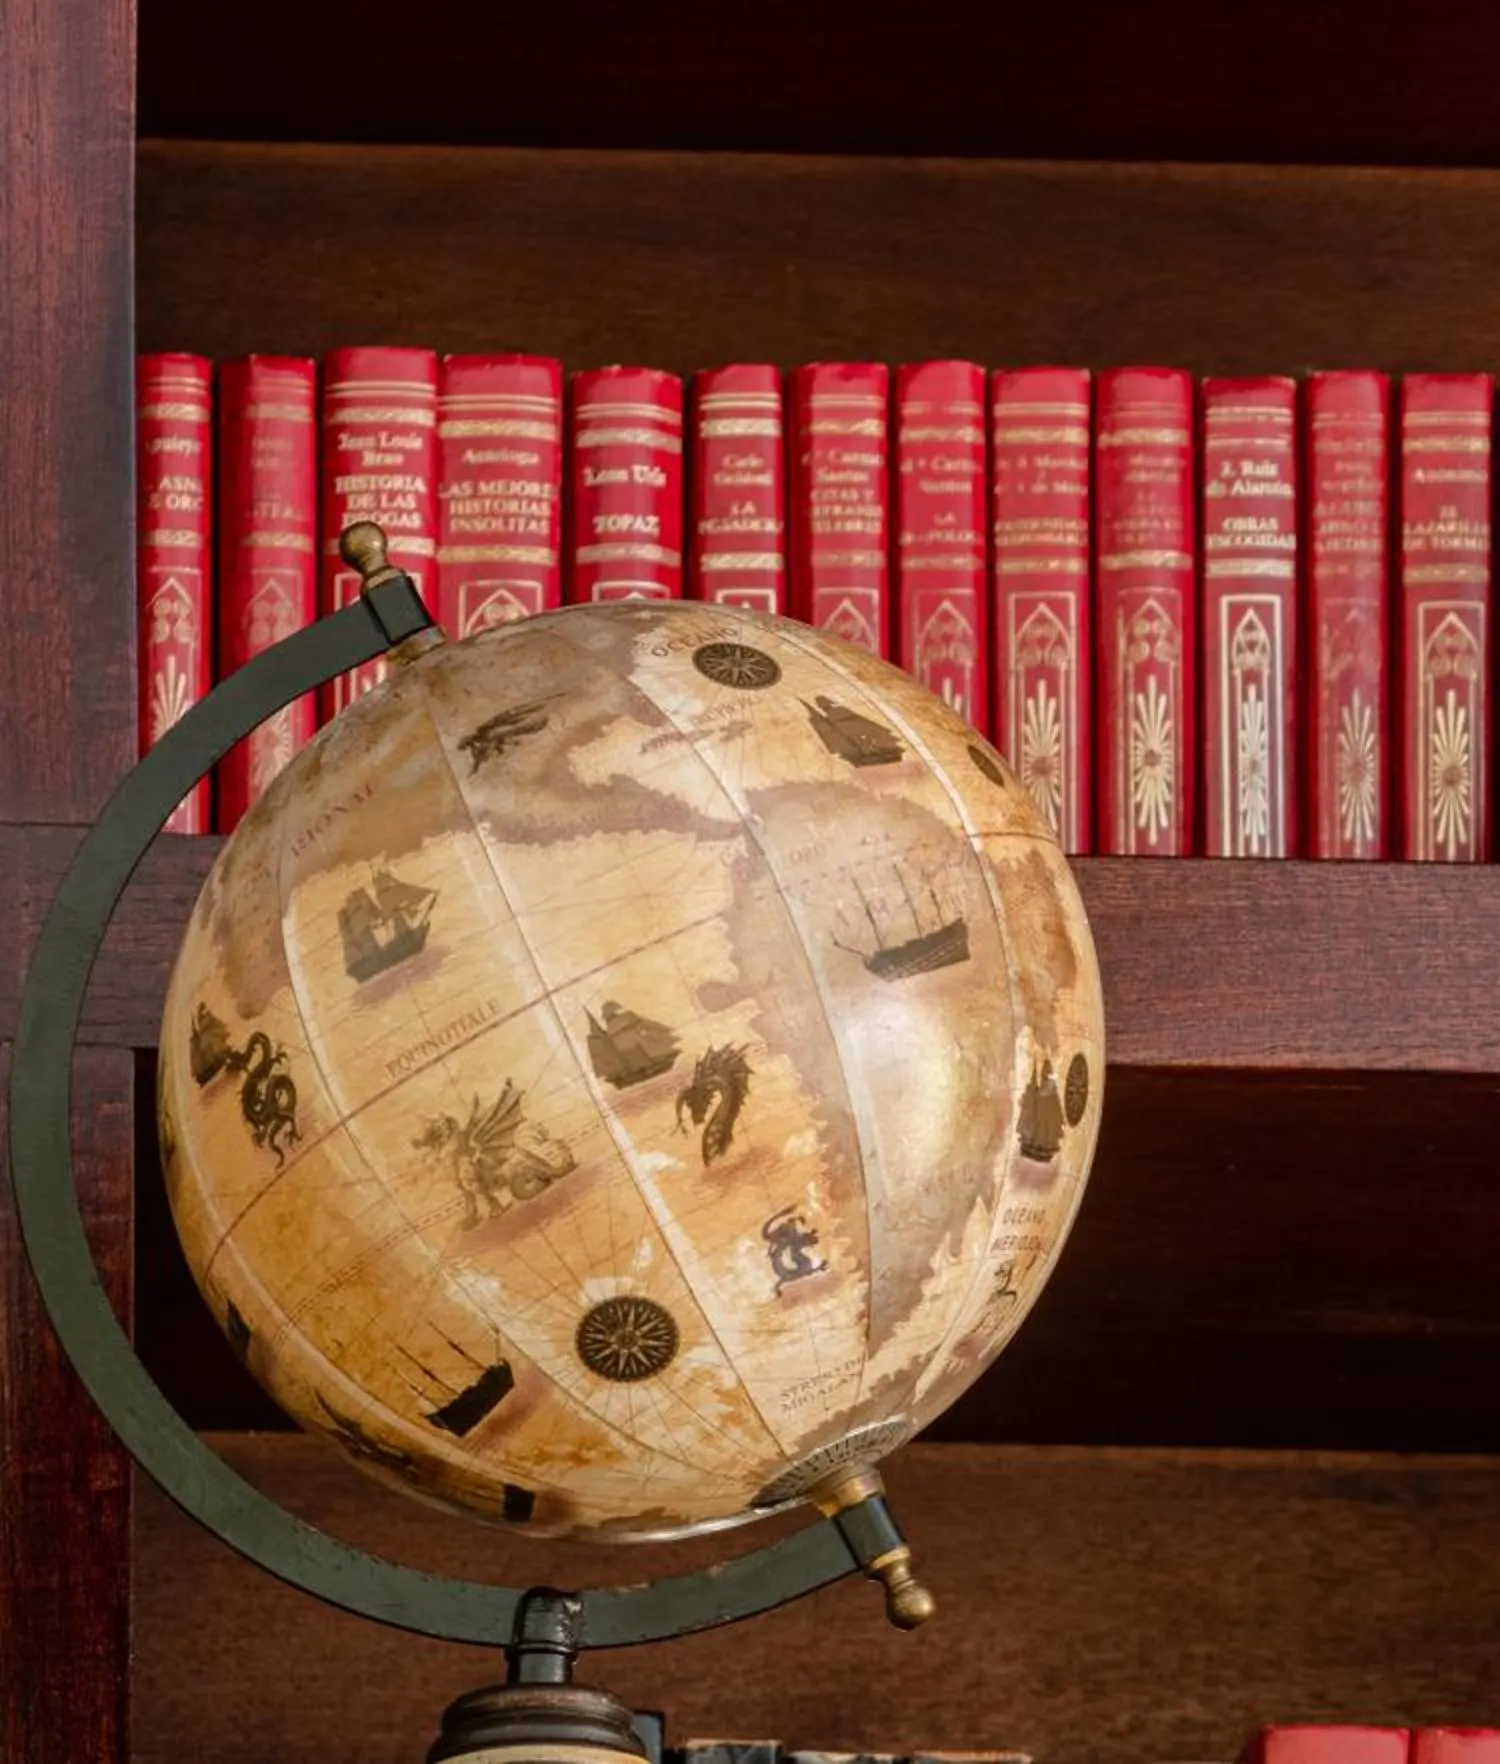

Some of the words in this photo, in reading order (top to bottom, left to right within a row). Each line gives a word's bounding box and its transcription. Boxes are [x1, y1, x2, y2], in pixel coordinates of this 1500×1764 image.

[335, 475, 427, 494] HISTORIA
[347, 494, 376, 510] DE
[380, 493, 417, 510] LAS
[451, 498, 550, 515] HISTORIAS
[592, 514, 661, 537] TOPAZ
